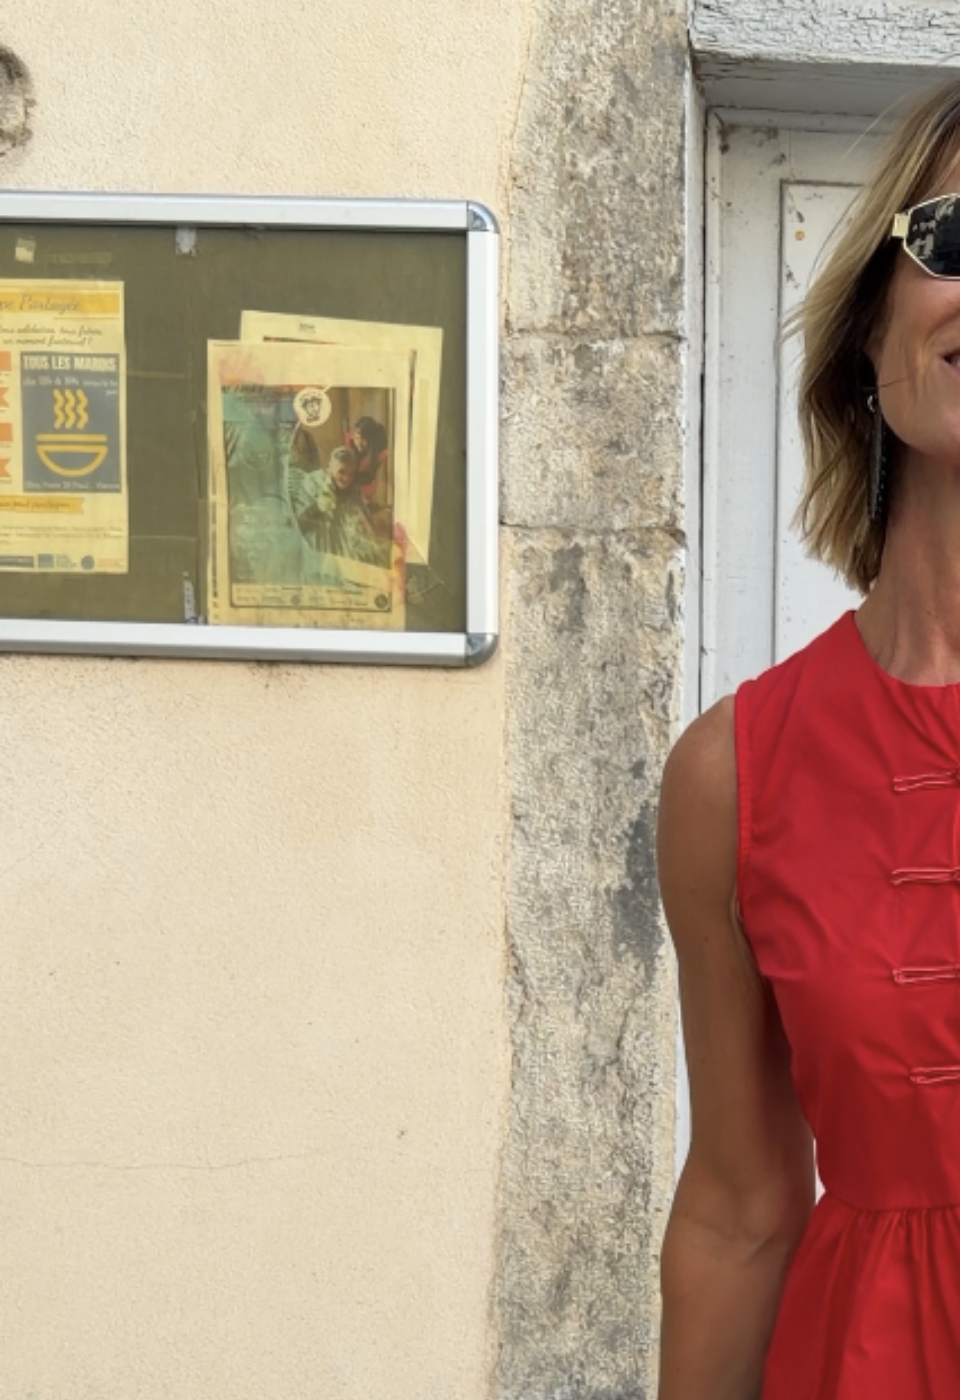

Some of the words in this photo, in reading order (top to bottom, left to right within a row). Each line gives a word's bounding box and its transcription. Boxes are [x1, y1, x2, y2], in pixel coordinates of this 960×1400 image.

[23, 355, 49, 370] TOUS
[51, 355, 71, 370] LES
[74, 357, 117, 373] MARDIS
